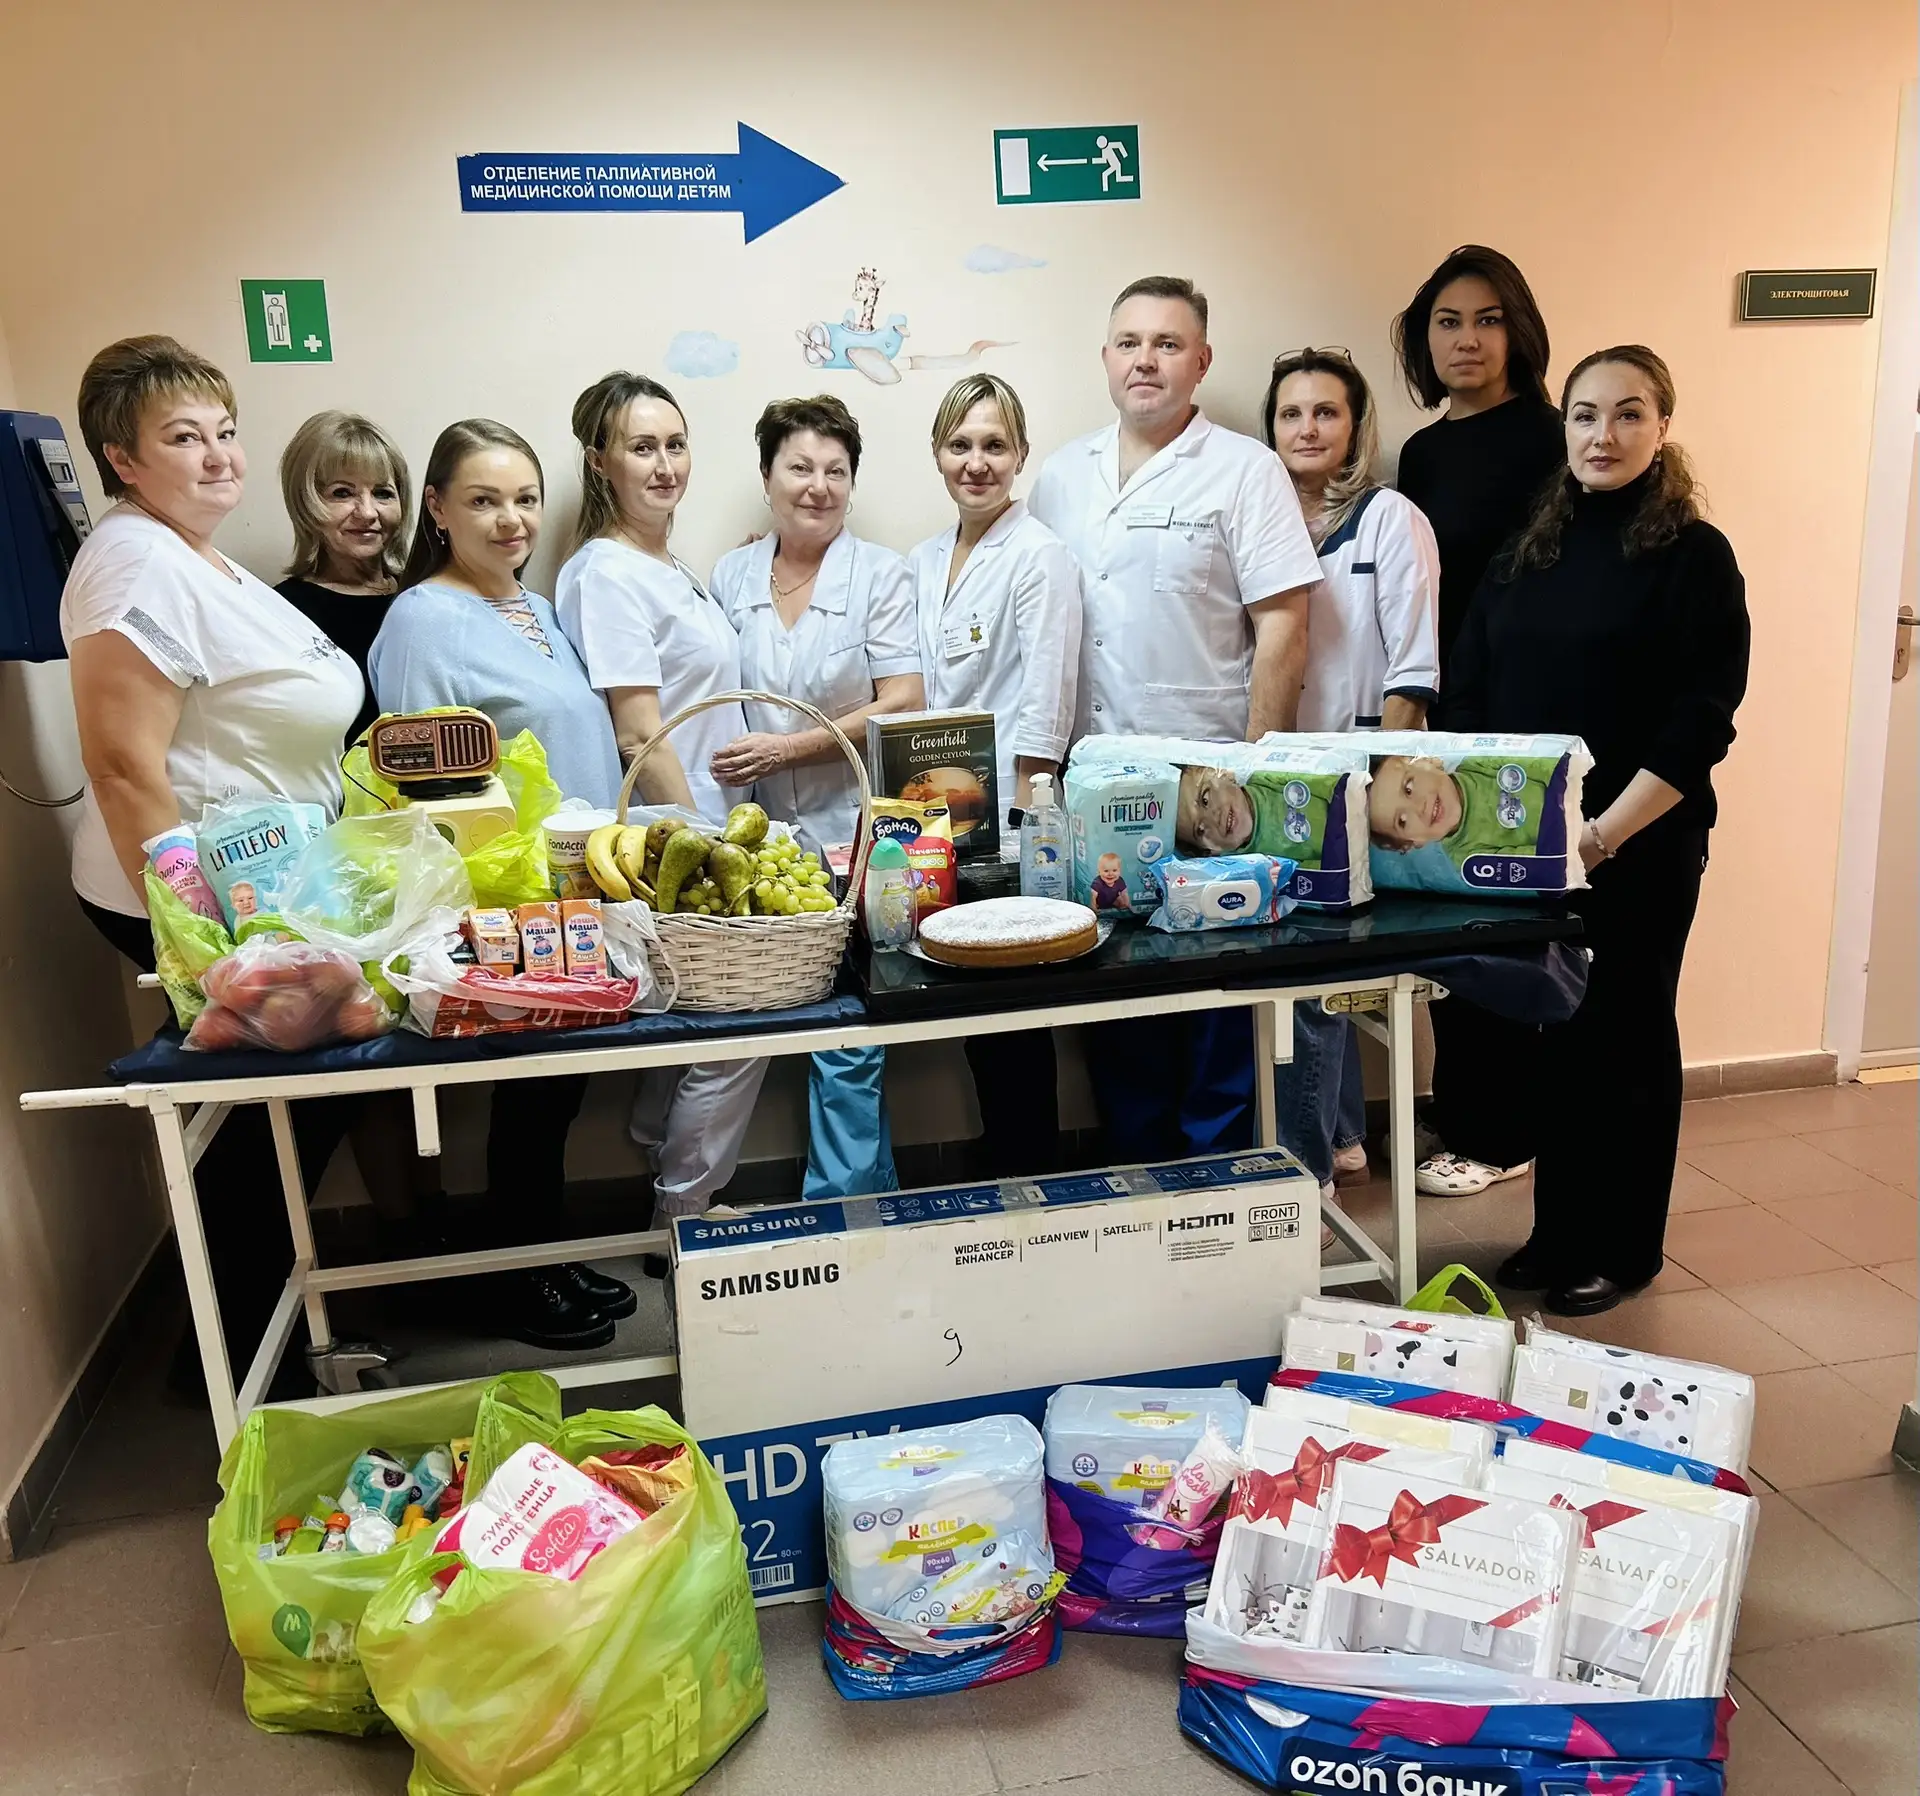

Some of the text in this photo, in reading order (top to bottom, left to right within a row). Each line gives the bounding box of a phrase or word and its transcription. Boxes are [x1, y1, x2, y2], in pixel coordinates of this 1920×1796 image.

[483, 164, 716, 182] ОТДЕЛЕНИЕ ПАЛЛИАТИВНОЙ
[471, 182, 731, 201] МЕДИЦИНСКОЙ ПОМОЩИ ДЕТЯМ
[1770, 289, 1849, 299] ЭЛЕКТРОЩИТОВАЯ
[911, 729, 967, 751] Greenfield
[909, 749, 971, 763] GOLDEN CEYLON
[1100, 801, 1164, 823] LITTLEJOY
[875, 822, 918, 840] БОНДИ
[209, 825, 288, 872] LITTLEJOY
[1472, 864, 1495, 878] 6
[170, 875, 197, 889] АТНЫЕ
[172, 880, 197, 893] ИСКИ
[1220, 896, 1243, 904] AURA
[525, 927, 557, 936] Маша
[568, 922, 599, 932] Маша
[1113, 1180, 1124, 1188] 2
[1253, 1206, 1296, 1221] FRONT
[694, 1215, 818, 1239] SAMSUNG
[1103, 1221, 1154, 1237] SATELLITE
[1167, 1212, 1234, 1232] HDMI
[1028, 1229, 1089, 1246] CLEAN VIEW
[1252, 1229, 1261, 1238] 10
[954, 1239, 1014, 1255] WIDE COLOR
[955, 1250, 1014, 1266] ENHANCER
[700, 1263, 840, 1301] SAMSUNG
[713, 1443, 807, 1502] HD
[908, 1516, 965, 1540] КАСПЕР
[529, 1521, 577, 1571] Sofita
[780, 1549, 791, 1558] 80
[1424, 1545, 1537, 1585] SALVADOR
[1028, 1585, 1041, 1597] 60
[1290, 1755, 1388, 1795] ozon
